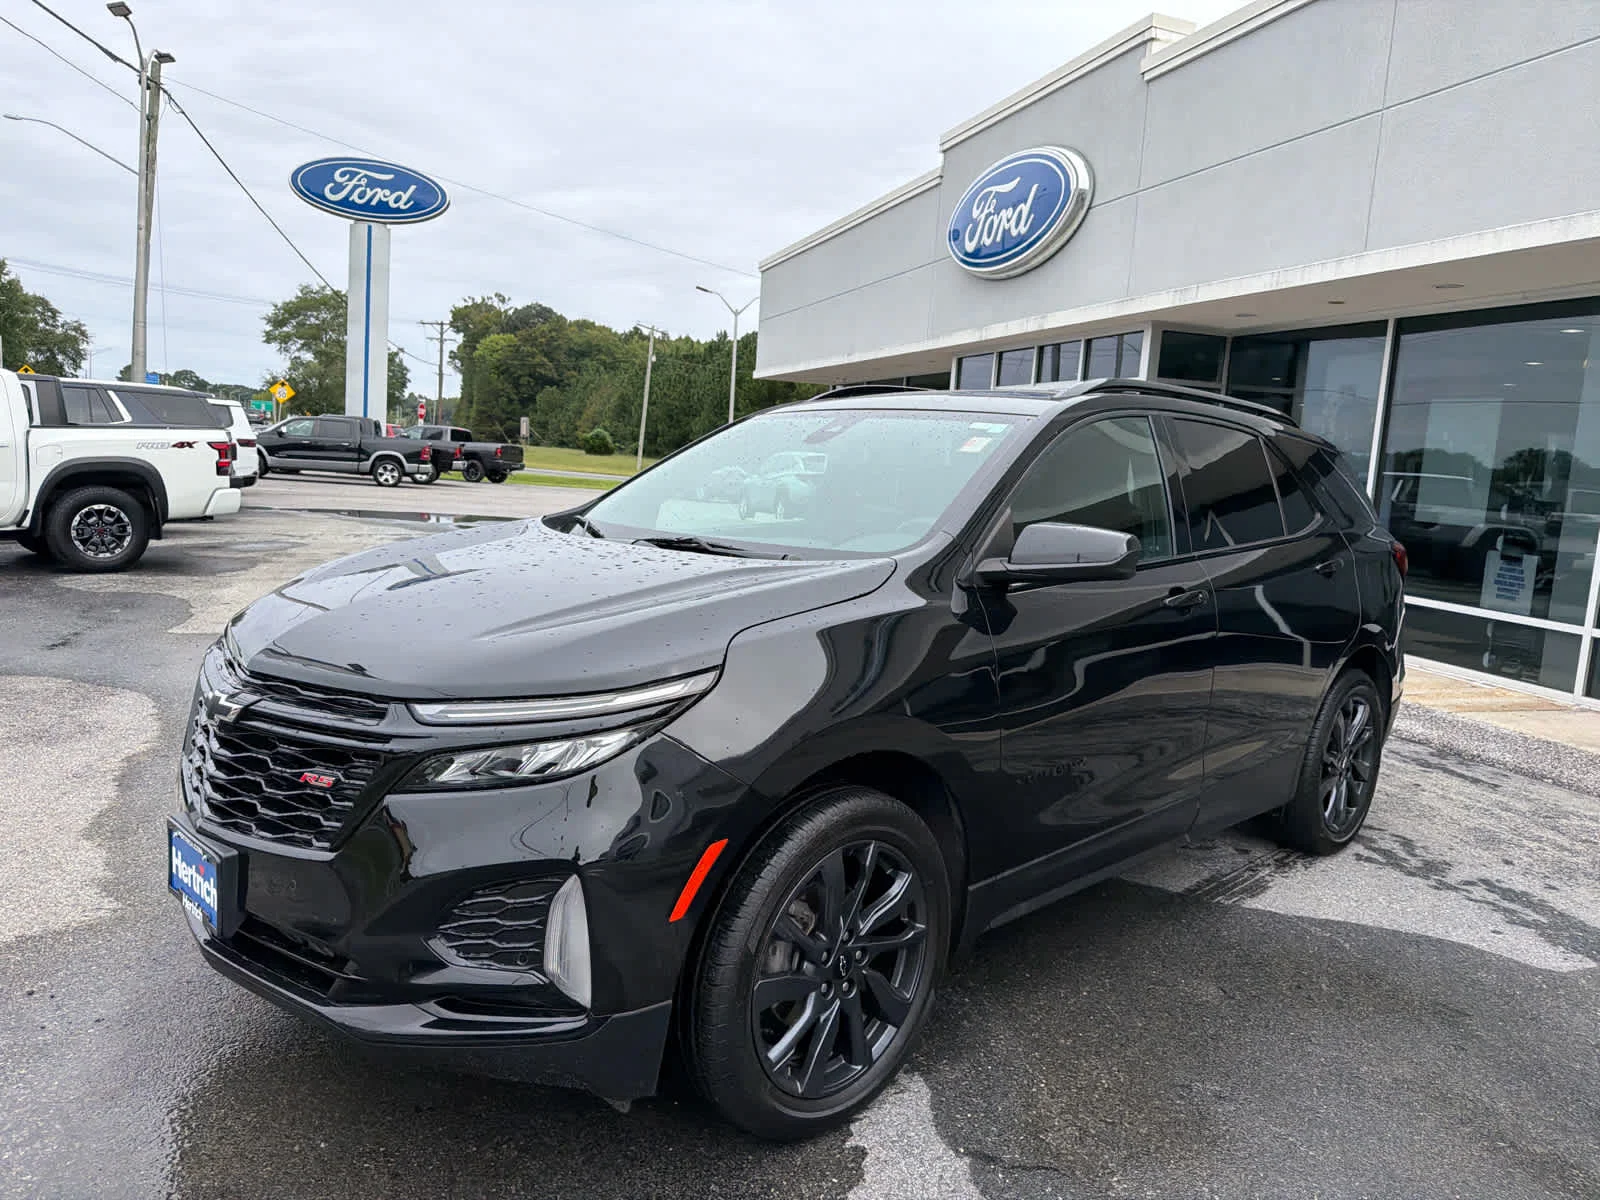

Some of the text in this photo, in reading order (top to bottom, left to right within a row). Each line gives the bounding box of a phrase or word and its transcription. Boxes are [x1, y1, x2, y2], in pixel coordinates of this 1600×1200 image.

[324, 167, 416, 209] Ford
[965, 177, 1039, 253] Ford
[300, 772, 335, 787] RS
[172, 844, 218, 913] Hertrich
